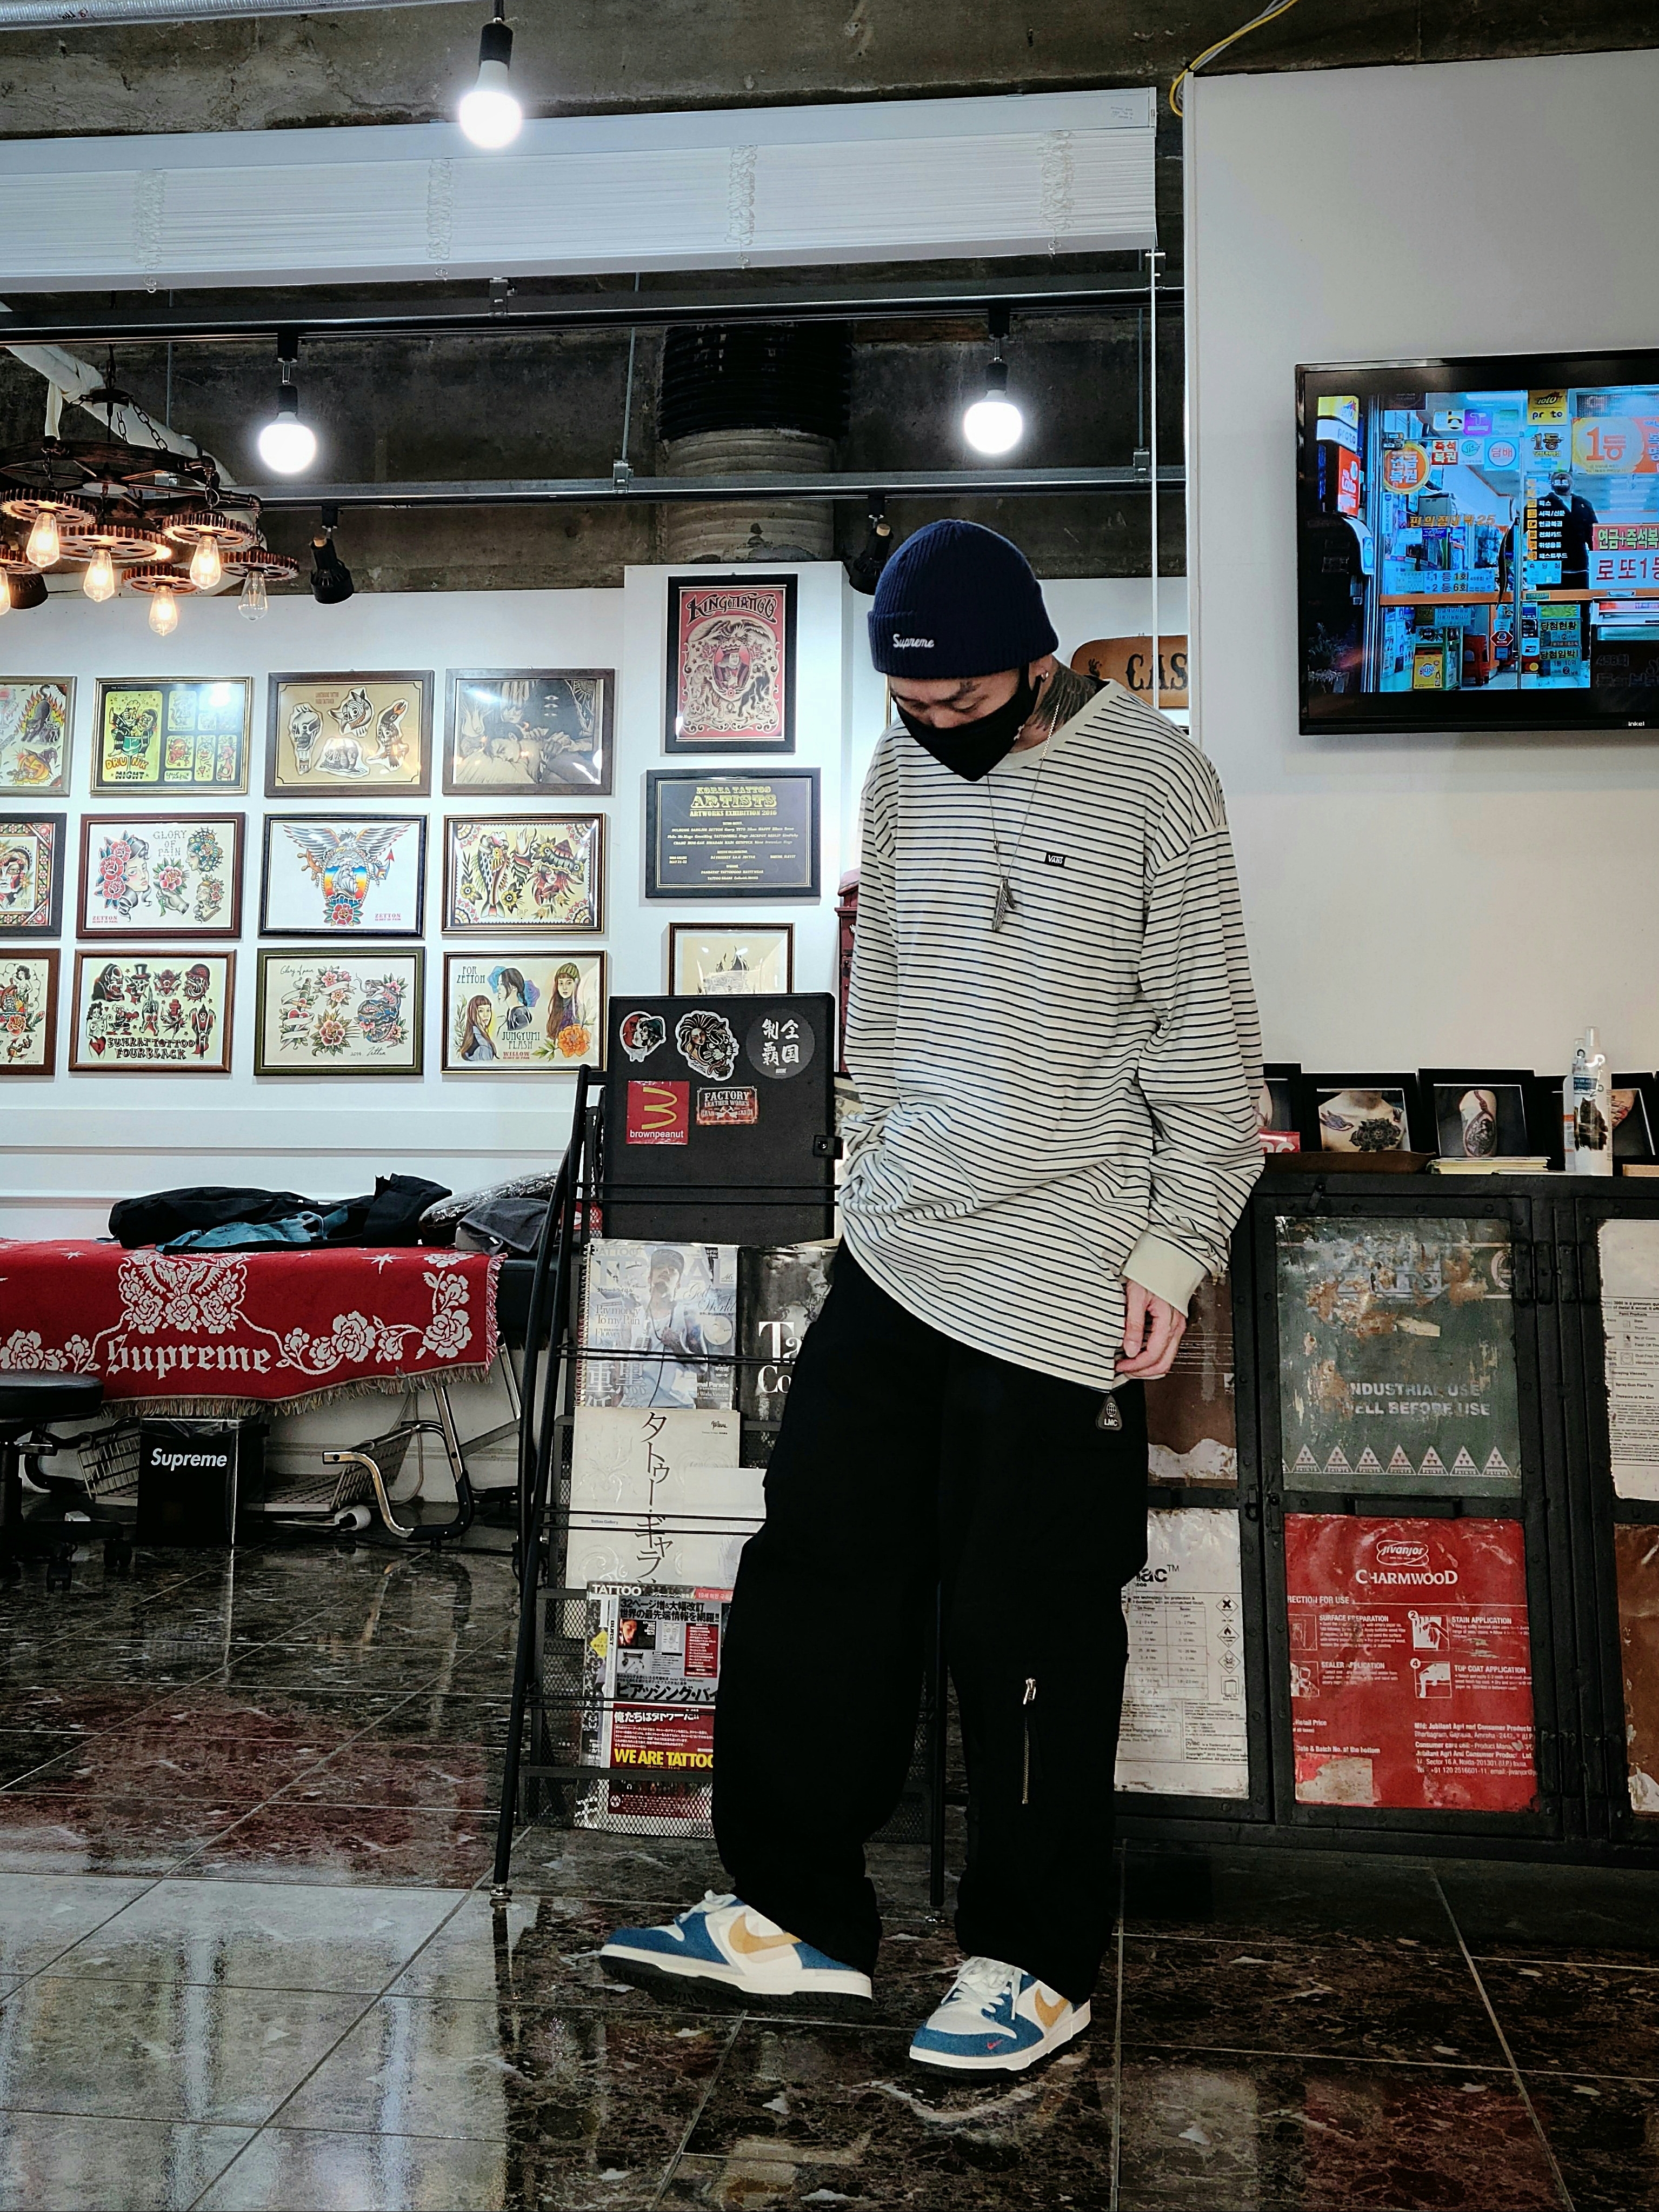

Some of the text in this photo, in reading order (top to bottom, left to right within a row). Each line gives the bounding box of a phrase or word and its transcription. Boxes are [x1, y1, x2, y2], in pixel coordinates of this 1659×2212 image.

[1586, 427, 1626, 460] 1등
[1434, 452, 1456, 463] 복권
[1491, 448, 1513, 457] 담배
[893, 633, 935, 650] Supreme
[115, 771, 145, 780] NIGHT
[732, 786, 771, 794] TATTOO
[690, 794, 777, 808] ARTISTS
[153, 830, 187, 840] GLORY
[164, 840, 176, 848] OF
[158, 848, 181, 857] PAIN
[1048, 854, 1064, 865] VANS
[463, 966, 477, 975] FOR
[457, 975, 485, 984] ZETTON
[502, 1032, 540, 1040] JUNGYUMI
[781, 1019, 799, 1063] 全国
[509, 1041, 532, 1050] FLASH
[115, 1047, 187, 1060] FOURBLACK
[704, 1091, 749, 1102] FACTORY
[630, 1130, 684, 1139] brownpeanut
[596, 1304, 640, 1317] Pay money
[596, 1314, 607, 1324] To
[608, 1316, 620, 1326] my
[106, 1334, 271, 1380] Supreme
[758, 1365, 792, 1393] Co
[1448, 1384, 1481, 1397] USE
[1388, 1401, 1454, 1415] BEFORE
[151, 1448, 227, 1471] Supreme
[635, 1412, 674, 1584] タトゥー・ギャラ
[1167, 1564, 1180, 1572] TM
[592, 1584, 642, 1596] TATTOO
[1319, 1596, 1334, 1604] FOR
[614, 1748, 637, 1763] WE
[638, 1750, 664, 1765] ARE
